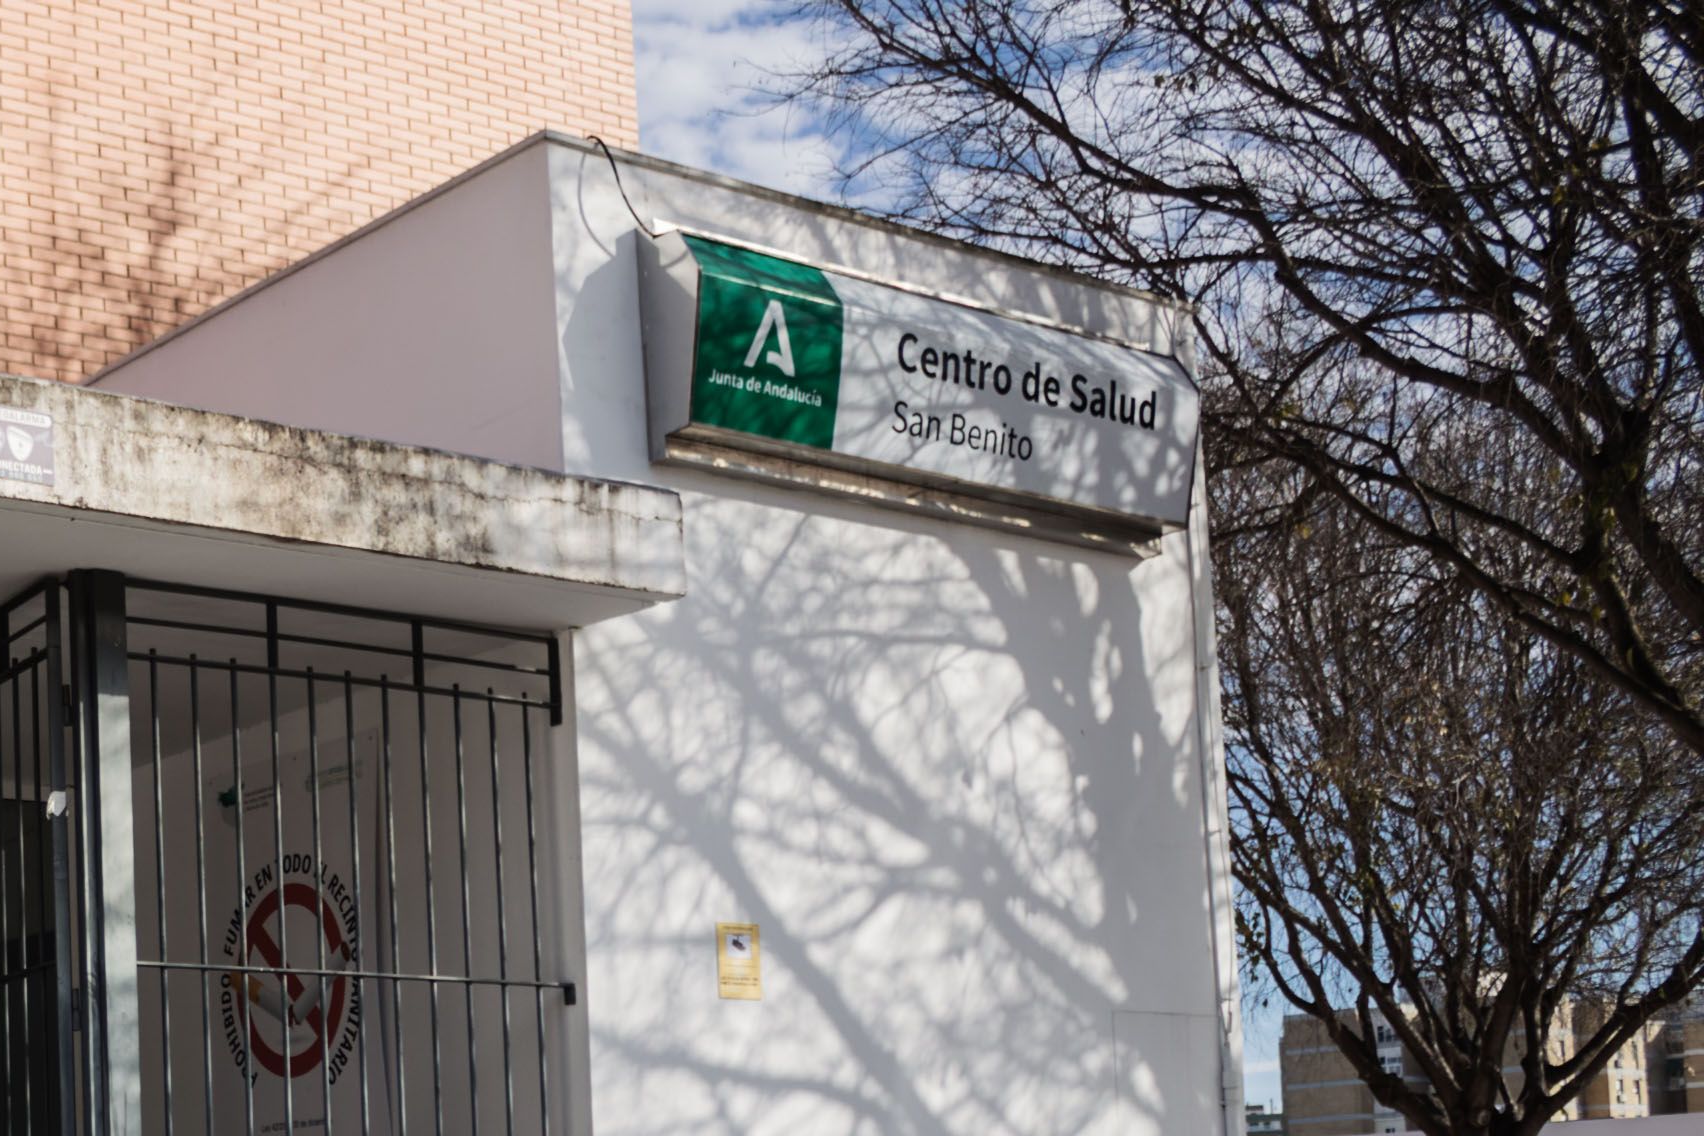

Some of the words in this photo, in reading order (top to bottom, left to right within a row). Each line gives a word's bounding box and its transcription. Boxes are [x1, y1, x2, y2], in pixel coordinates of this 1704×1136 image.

[708, 368, 745, 390] Junta
[745, 375, 762, 394] de
[762, 380, 823, 408] Andalucía
[897, 332, 1013, 396] Centro
[1021, 362, 1060, 408] de
[1068, 373, 1157, 431] Salud
[892, 400, 941, 442] San
[950, 413, 1033, 462] Benito
[254, 864, 273, 892] EN
[275, 853, 312, 875] ODO
